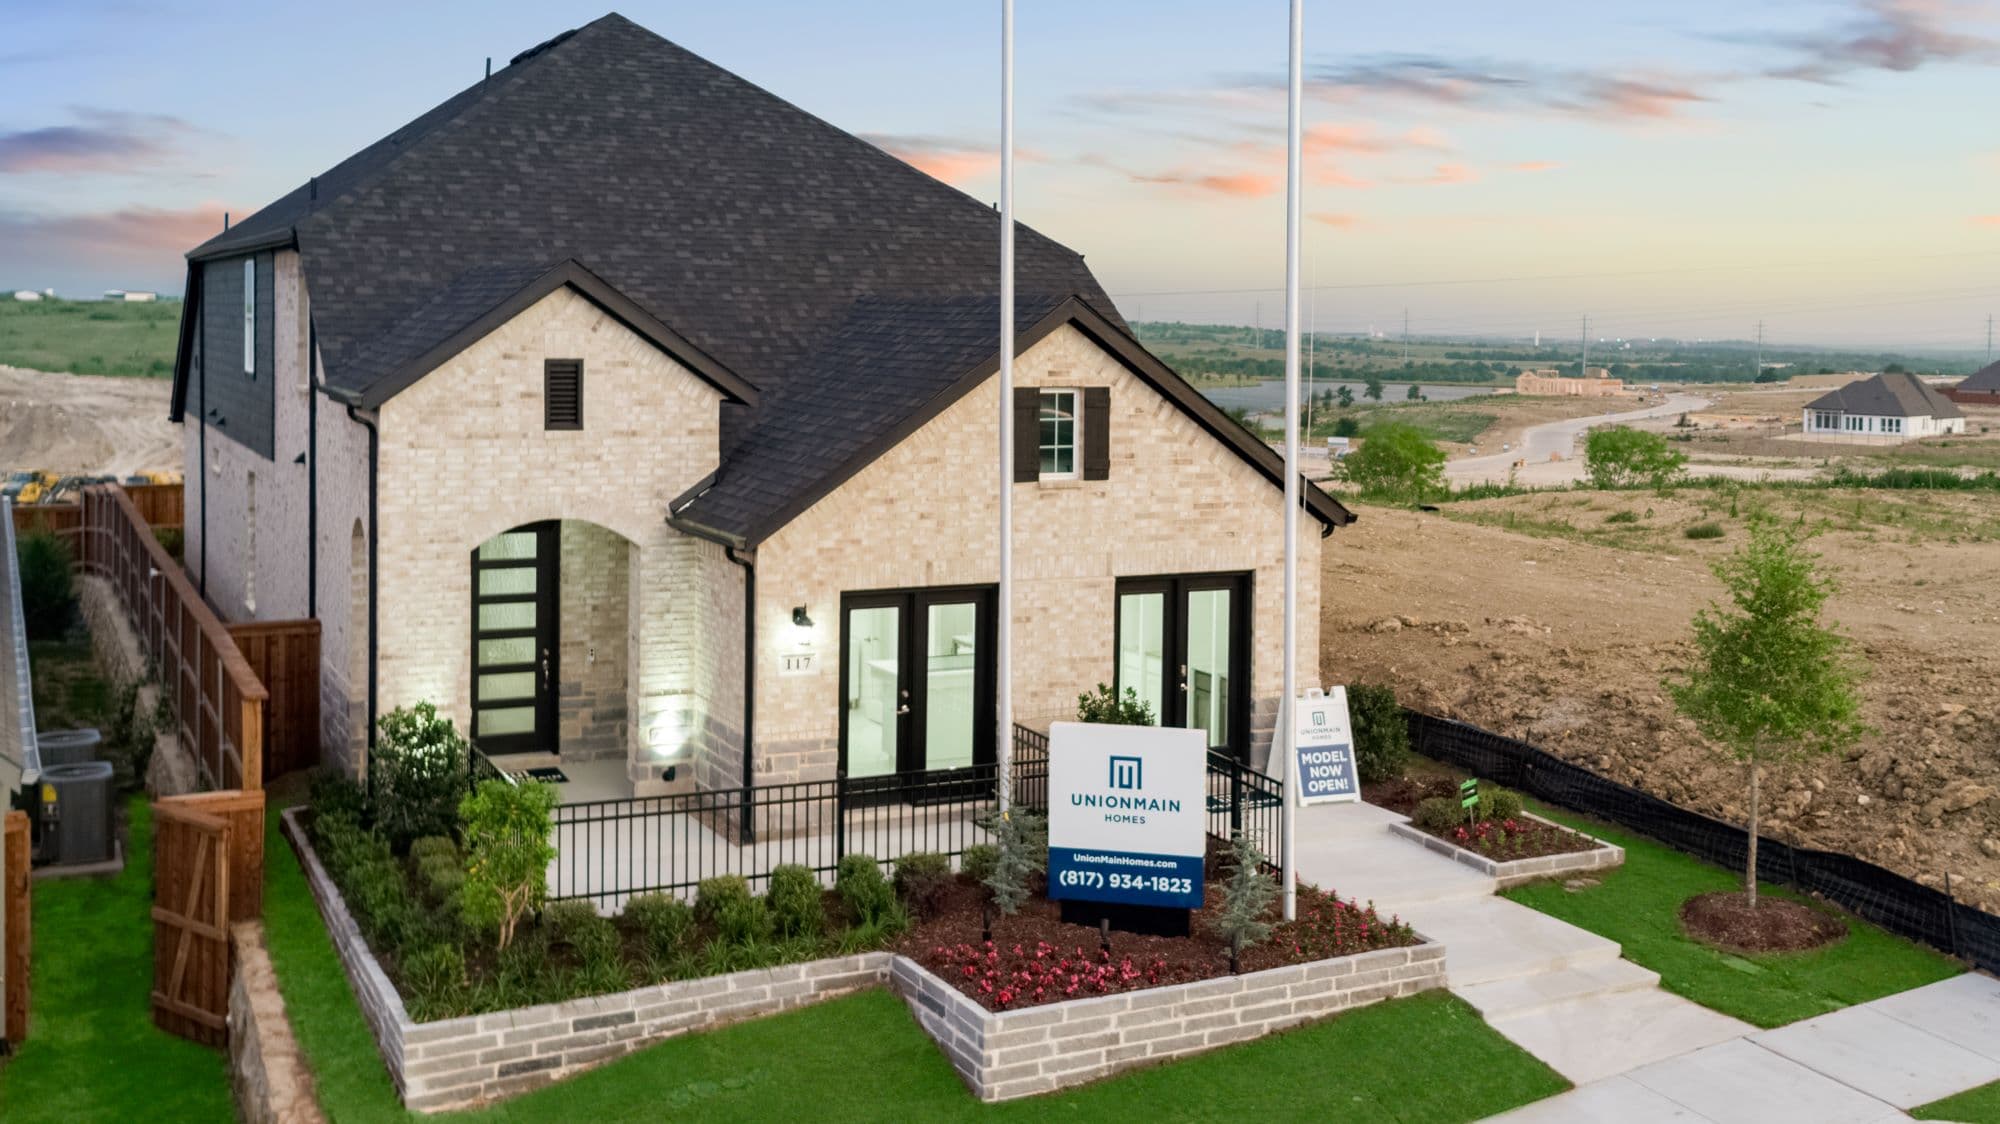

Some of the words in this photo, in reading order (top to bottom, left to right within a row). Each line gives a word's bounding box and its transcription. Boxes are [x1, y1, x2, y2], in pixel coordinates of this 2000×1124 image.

[787, 657, 811, 670] 117
[1301, 750, 1348, 765] MODEL
[1309, 764, 1342, 778] NOW
[1308, 778, 1349, 792] OPEN!
[1071, 793, 1181, 813] UNIONMAIN
[1104, 814, 1146, 825] HOMES
[1073, 853, 1177, 869] UnionMainHomes.com
[1059, 870, 1104, 889] (817)
[1109, 873, 1192, 893] 934-1823
